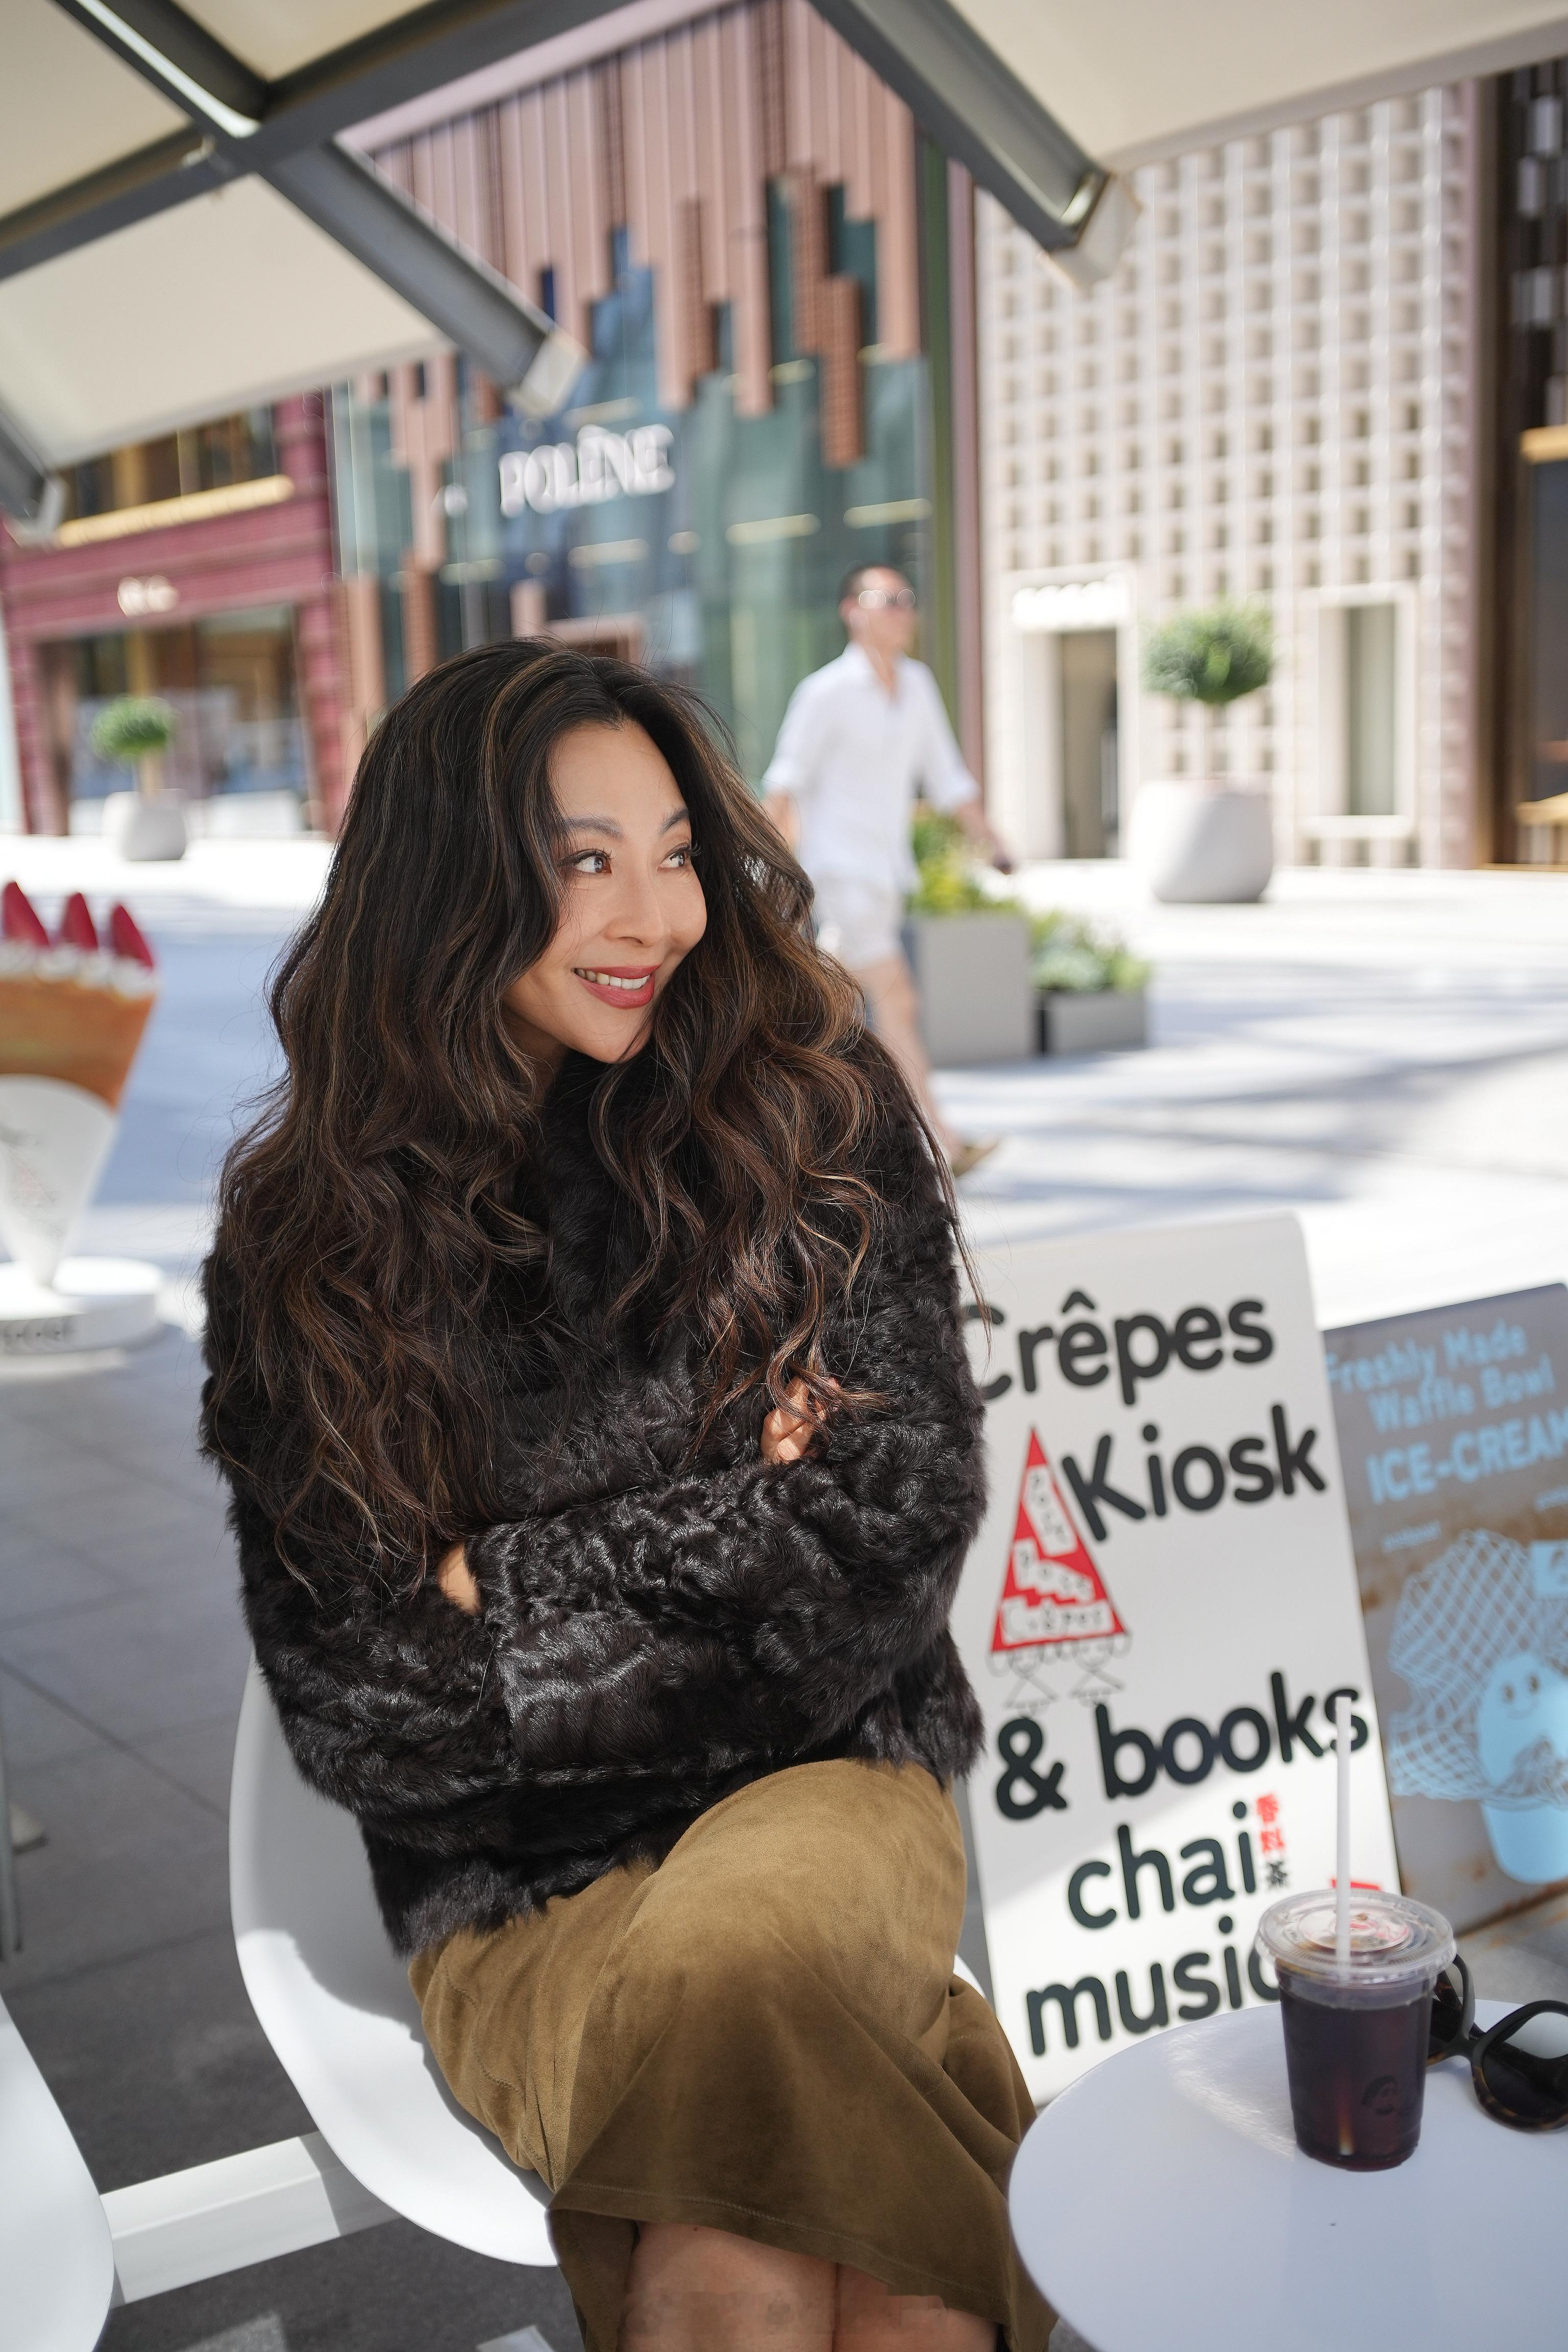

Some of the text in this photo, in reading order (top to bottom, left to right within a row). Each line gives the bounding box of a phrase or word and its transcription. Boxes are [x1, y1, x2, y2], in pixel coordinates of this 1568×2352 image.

[1367, 1352, 1556, 1433] Waffle Bowl
[1442, 1318, 1528, 1370] Made
[1060, 1403, 1327, 1543] Kiosk
[994, 1671, 1369, 1822] & books
[1067, 1801, 1257, 1930] chai
[1025, 1915, 1281, 2057] music
